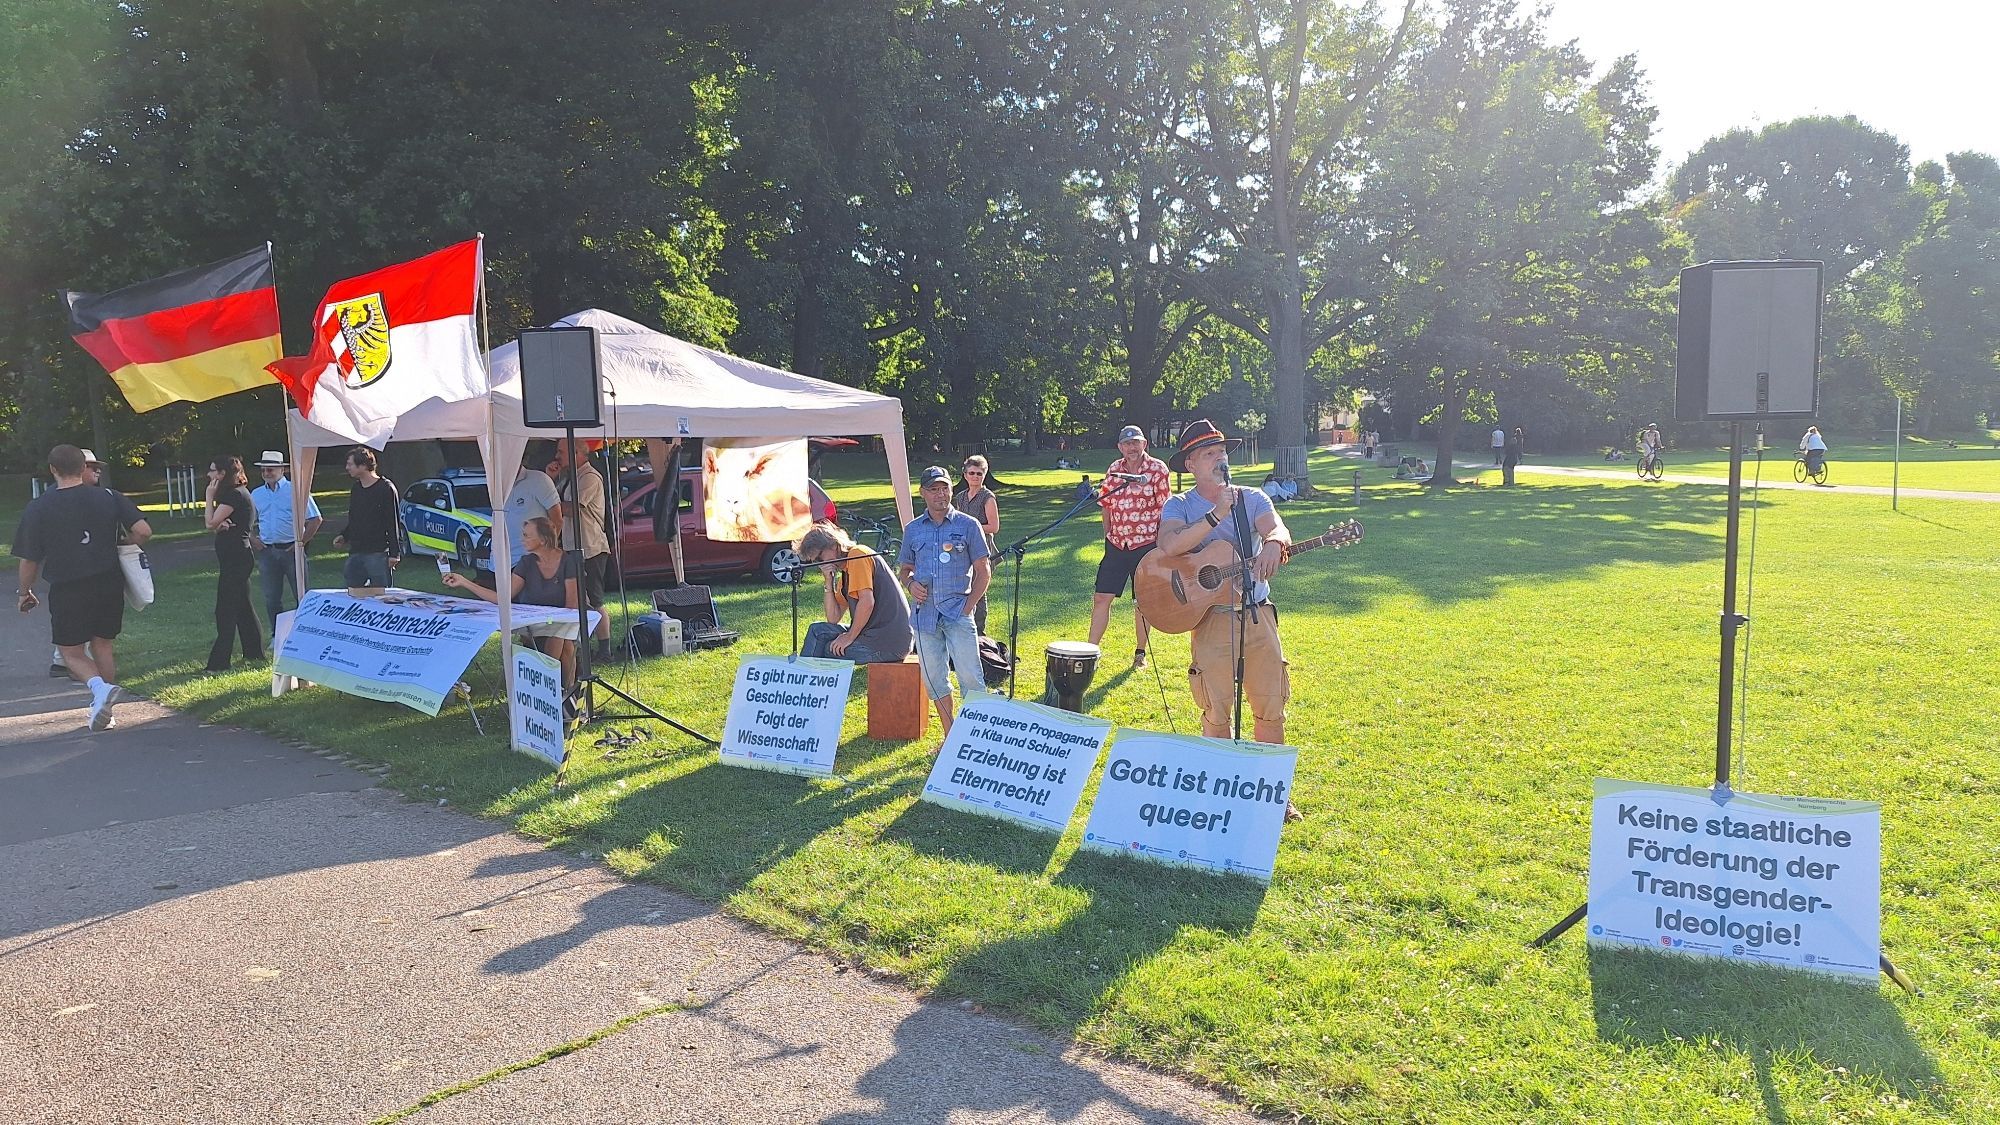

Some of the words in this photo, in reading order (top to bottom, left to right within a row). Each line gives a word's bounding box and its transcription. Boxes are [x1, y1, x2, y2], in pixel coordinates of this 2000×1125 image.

[426, 521, 445, 534] POLIZEI
[315, 600, 344, 620] Team
[340, 602, 451, 636] Menschenrechte
[518, 660, 542, 687] Finger
[543, 674, 557, 697] weg
[746, 667, 760, 681] Es
[761, 668, 785, 686] gibt
[786, 673, 808, 684] nur
[809, 674, 839, 688] zwei
[516, 690, 532, 708] von
[533, 696, 559, 722] unseren
[746, 688, 829, 709] Geschlechter!
[525, 715, 556, 748] Kindern!
[755, 710, 786, 729] Folgt
[787, 714, 809, 729] der
[959, 707, 988, 723] Keine
[989, 715, 1028, 731] queere
[1028, 722, 1100, 749] Propaganda
[737, 729, 820, 753] Wissenschaft!
[969, 726, 980, 737] in
[981, 729, 1002, 742] Kita
[1003, 734, 1026, 748] und
[1026, 739, 1071, 759] Schule!
[956, 743, 1041, 781] Erziehung
[1042, 764, 1068, 785] ist
[1109, 758, 1169, 788] Gott
[1172, 767, 1208, 794] ist
[1212, 774, 1286, 805] nicht
[950, 767, 1052, 807] Elternrecht!
[1139, 803, 1232, 834] queer!
[1618, 804, 1698, 833] Keine
[1705, 816, 1852, 848] staatliche
[1627, 837, 1778, 881] Förderung
[1786, 856, 1841, 881] der
[1632, 870, 1833, 913] Transgender-
[1655, 906, 1801, 947] Ideologie!
